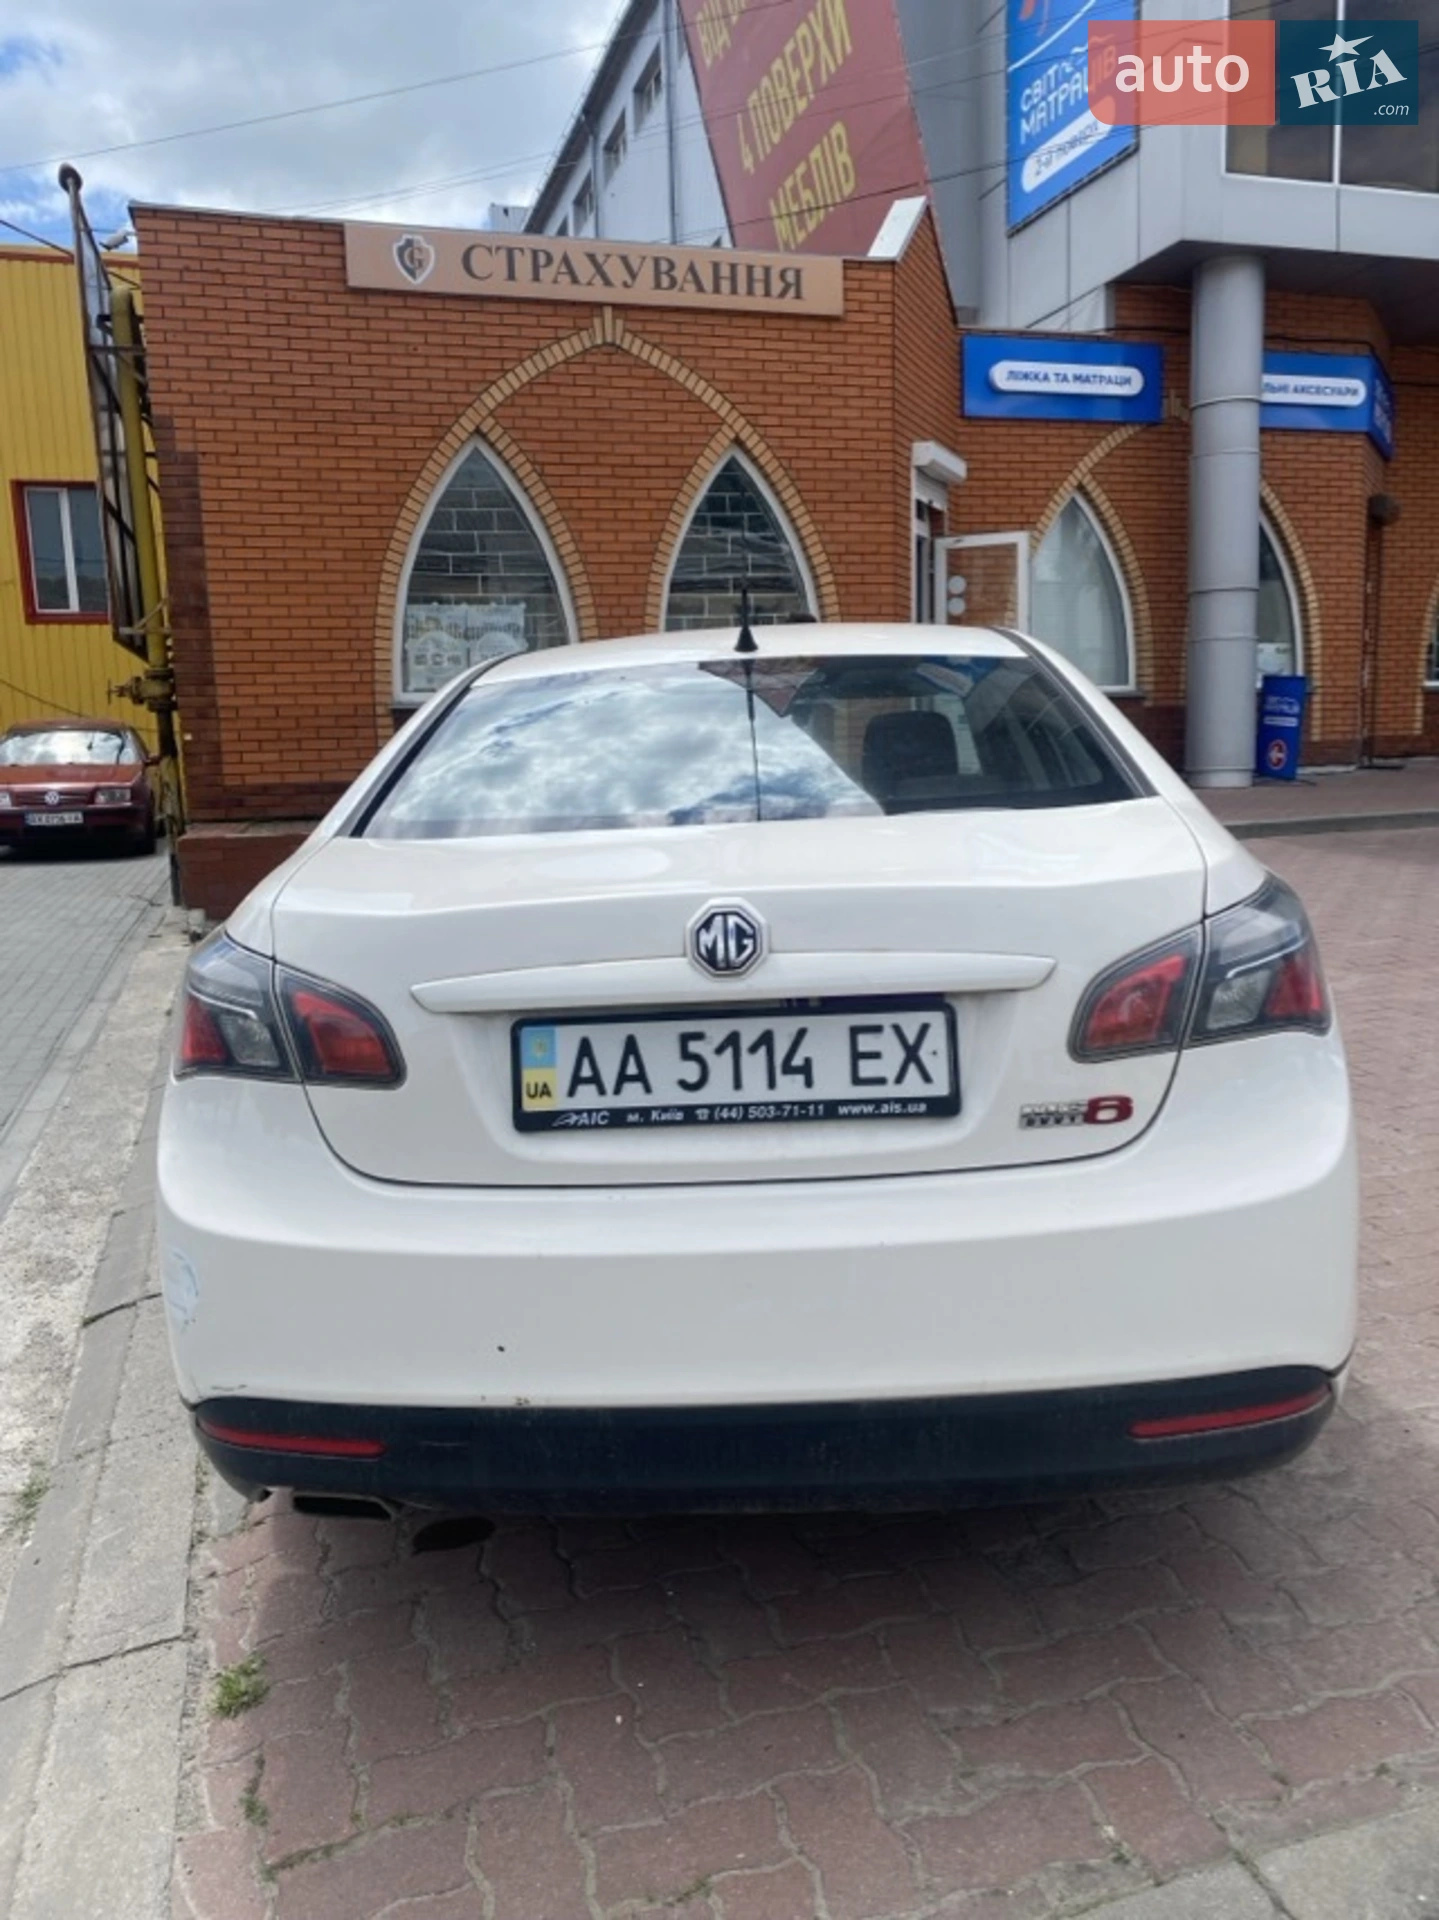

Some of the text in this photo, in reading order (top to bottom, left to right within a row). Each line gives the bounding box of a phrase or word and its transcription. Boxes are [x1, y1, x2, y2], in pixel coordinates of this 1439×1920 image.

[748, 0, 853, 162] ПОВЕРХИ
[769, 120, 856, 252] МЕБЛІВ
[461, 243, 804, 300] СТРАХУВАННЯ
[1053, 372, 1070, 384] ТА
[1072, 372, 1133, 387] МАТРАЦИ
[699, 914, 755, 968] MG
[567, 1022, 934, 1098] AA 5114 EX
[526, 1082, 552, 1099] UA
[713, 1105, 744, 1121] (44)
[747, 1103, 825, 1119] 503-71-11
[837, 1101, 928, 1116] www.ais.ua
